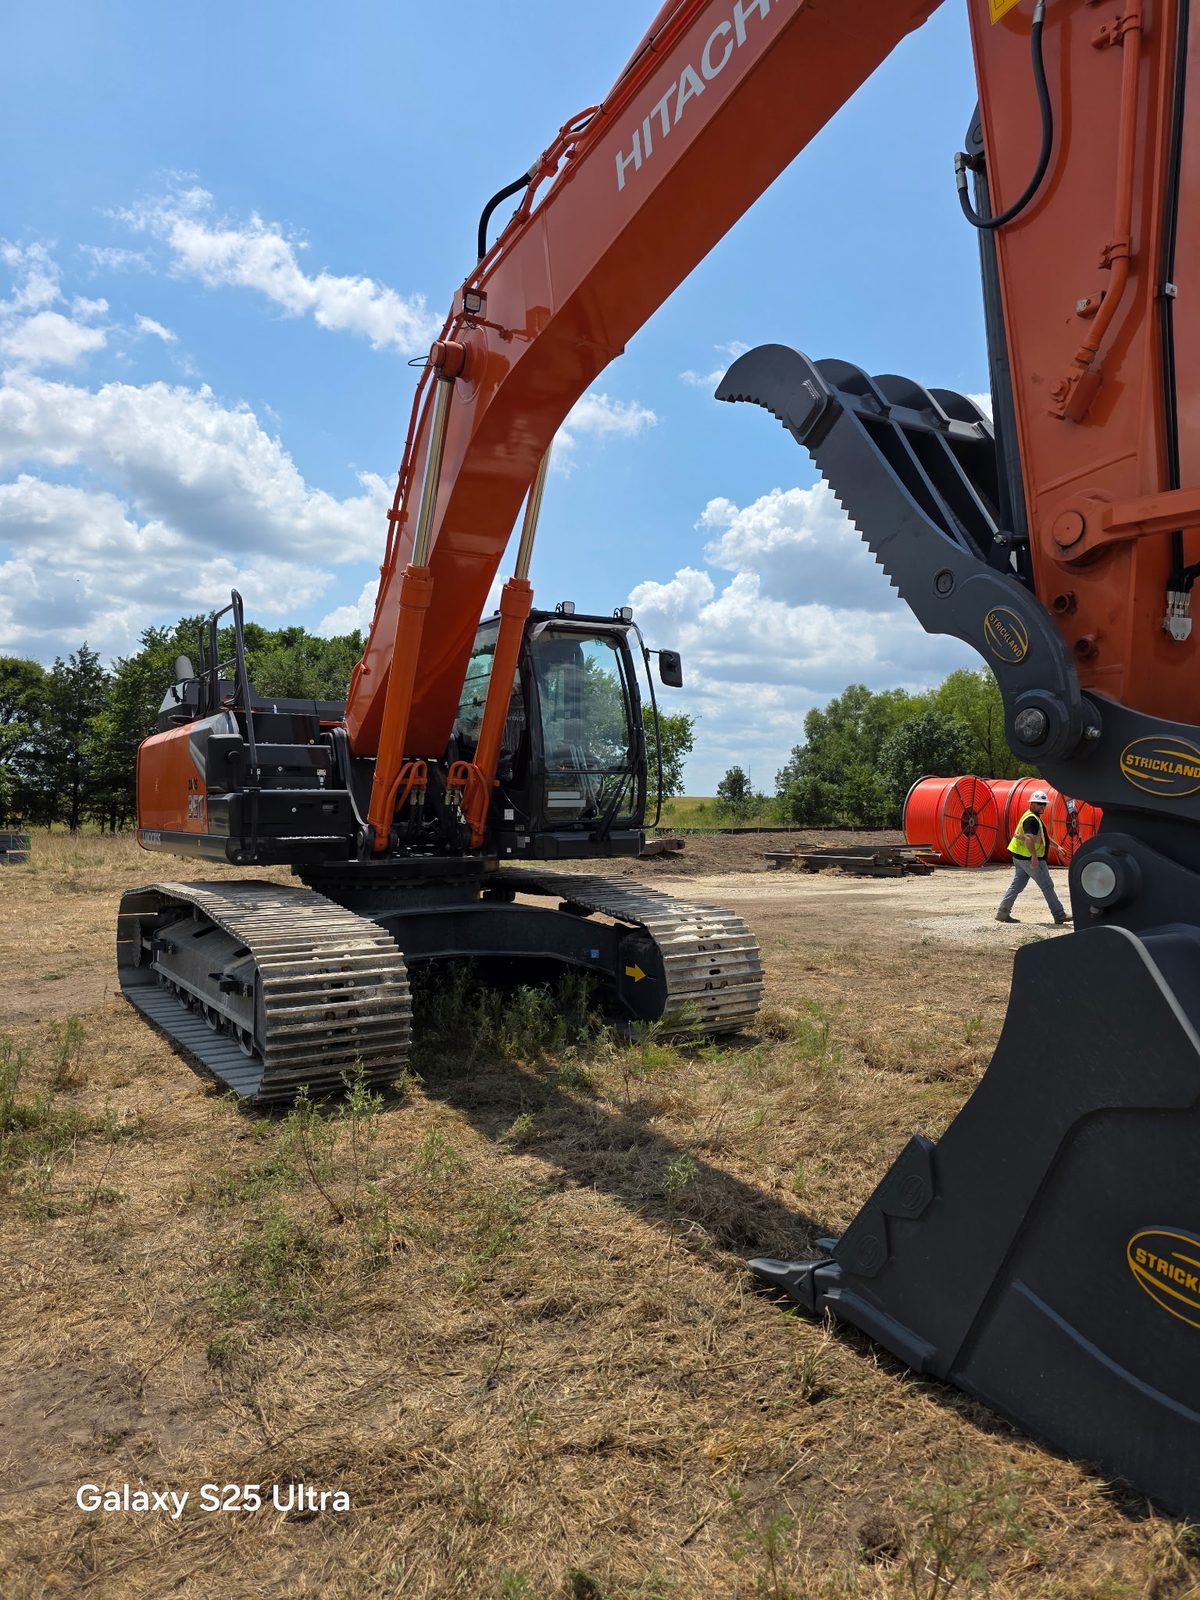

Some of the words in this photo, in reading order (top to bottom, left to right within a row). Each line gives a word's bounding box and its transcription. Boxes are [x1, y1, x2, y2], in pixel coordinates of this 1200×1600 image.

[615, 0, 782, 191] HITACH
[989, 613, 1023, 658] STRICKLAND
[1125, 754, 1200, 778] STRICKLAND
[1135, 1247, 1200, 1294] STRICK
